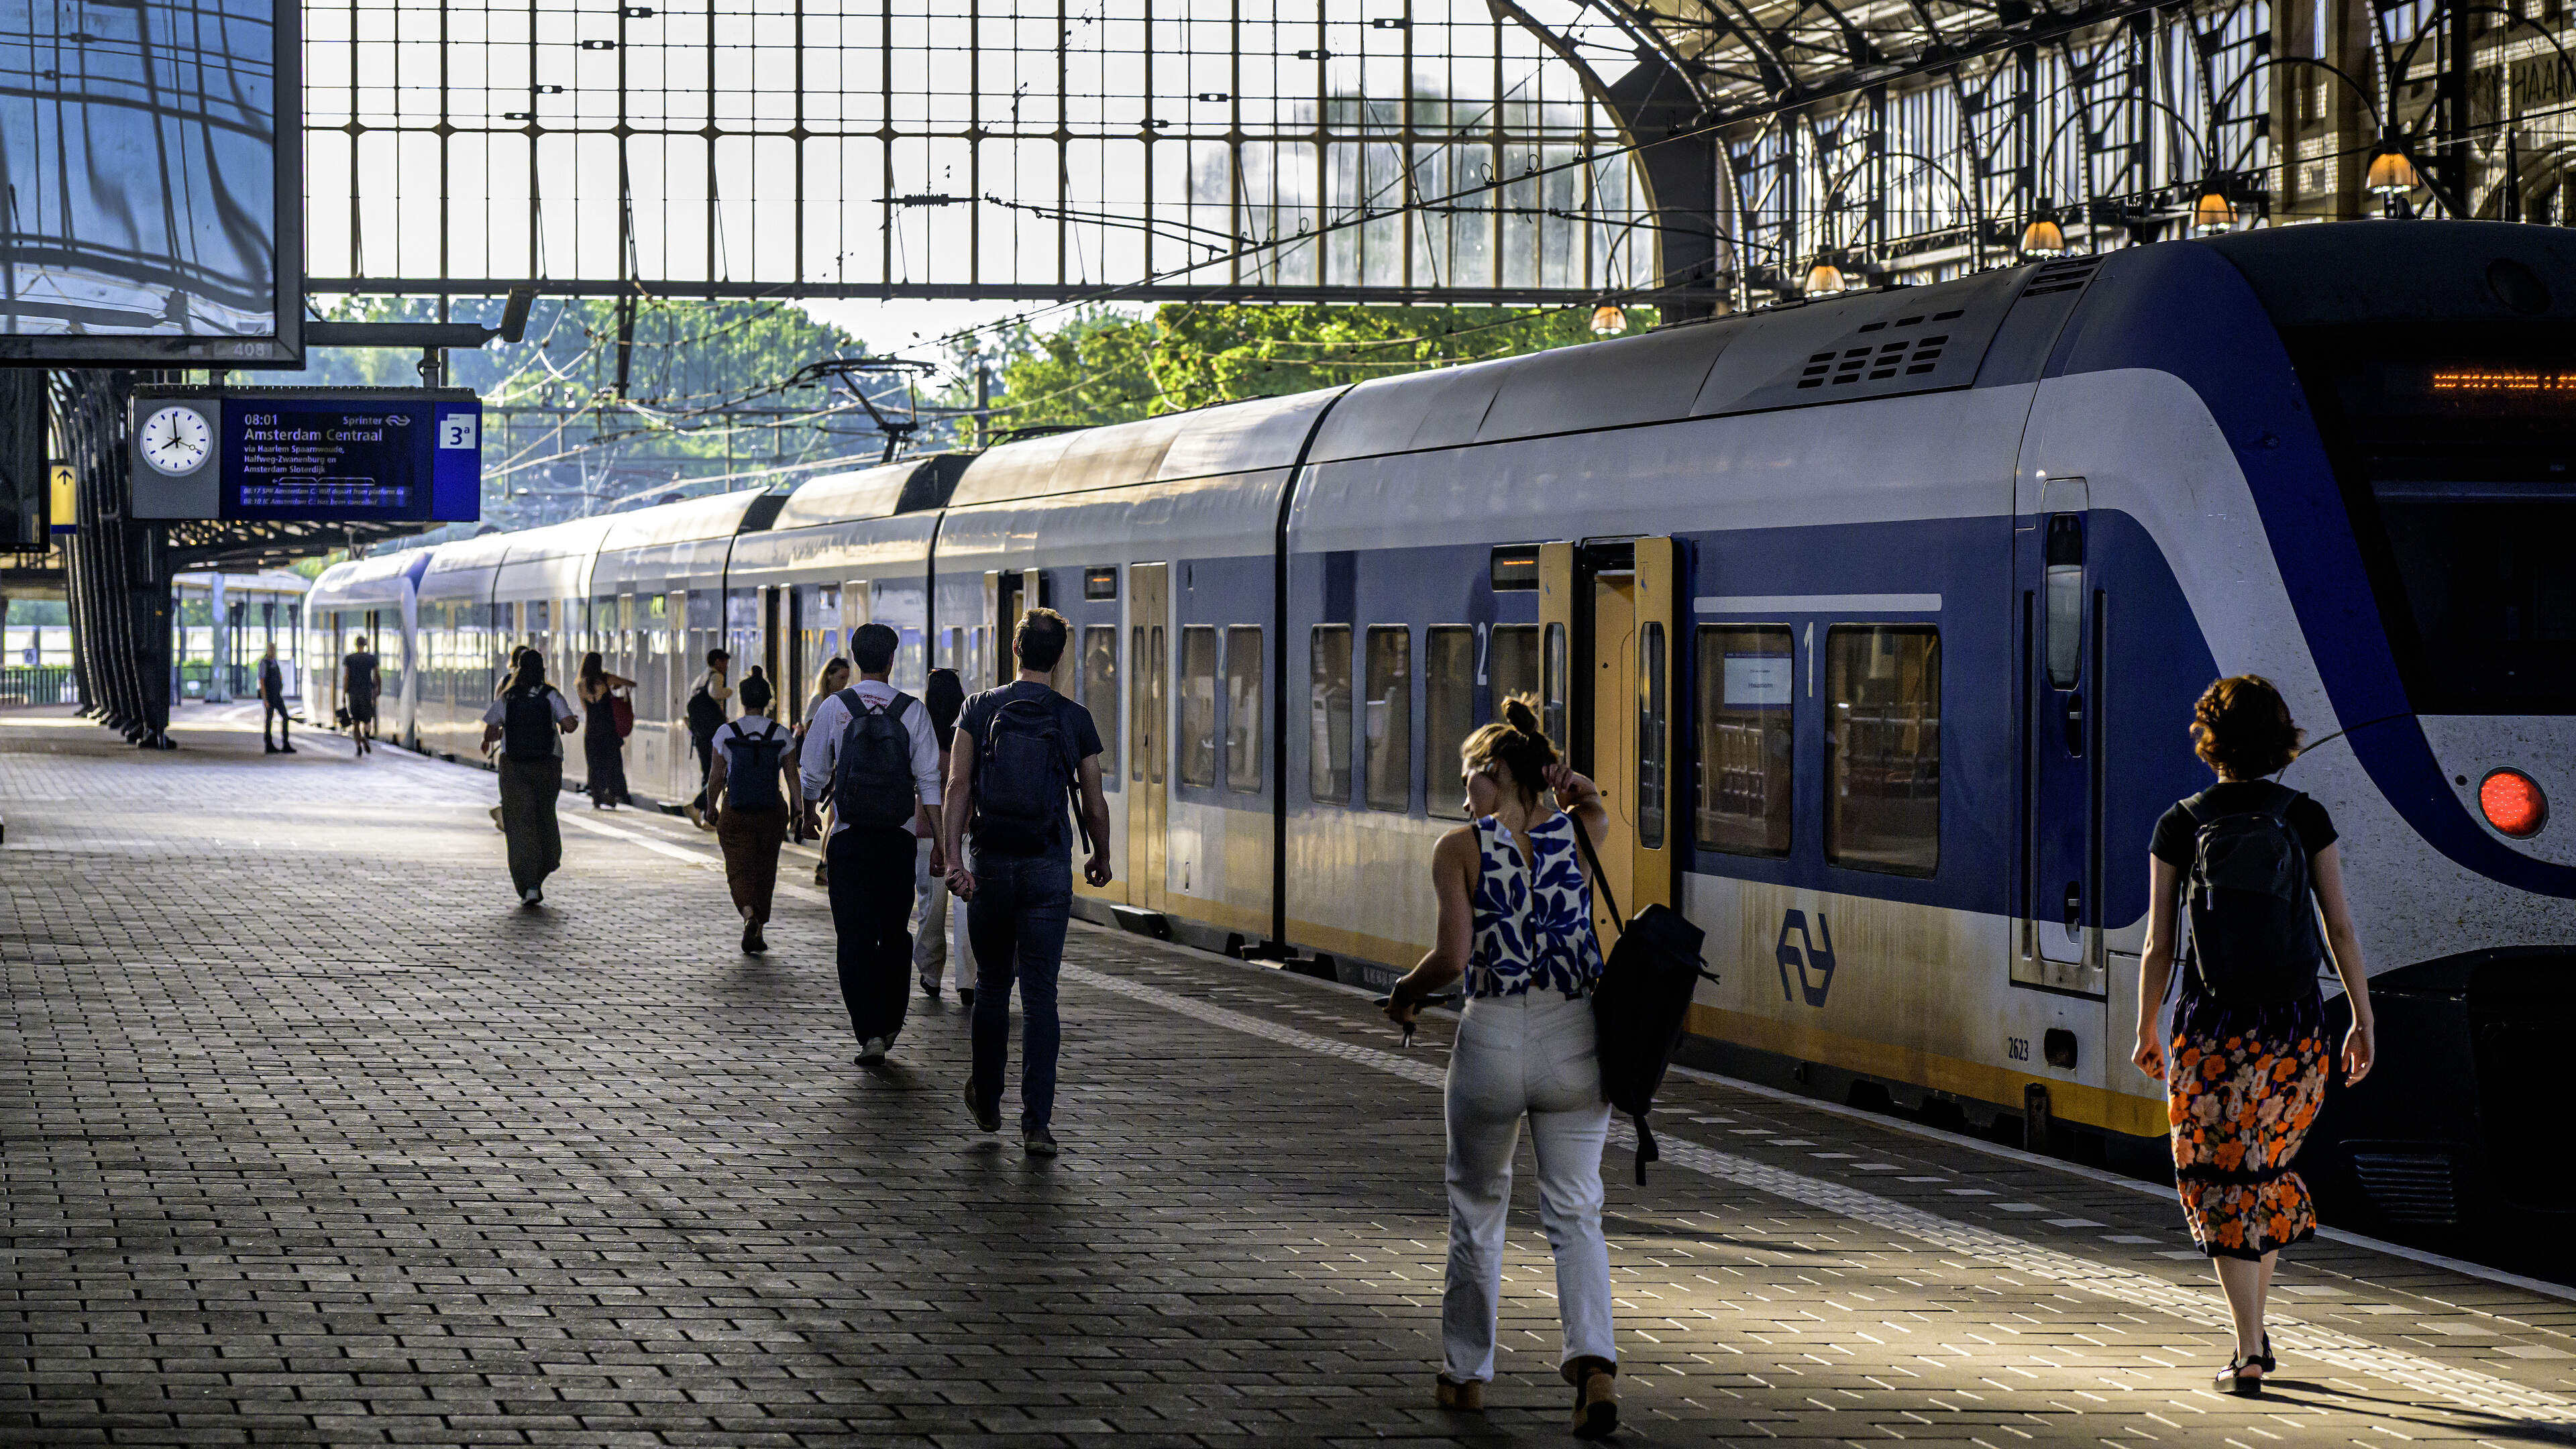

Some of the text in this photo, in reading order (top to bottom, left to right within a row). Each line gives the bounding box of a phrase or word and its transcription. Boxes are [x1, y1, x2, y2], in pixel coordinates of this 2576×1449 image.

[234, 343, 264, 356] 408
[244, 414, 278, 425] 08:01
[343, 416, 382, 427] Sprinter
[244, 428, 382, 441] Amsterdam Centraal
[258, 444, 289, 453] Haarlem
[291, 445, 344, 454] Spaarnwoude,
[244, 455, 325, 464] Halfweg-Zwanenburg
[244, 465, 325, 474] Amsterdam Sloterdijk
[368, 488, 395, 496] platform
[1218, 627, 1225, 680] 2
[1477, 621, 1487, 686] 2
[1803, 622, 1813, 698] 1
[2008, 1036, 2029, 1062] 2623
